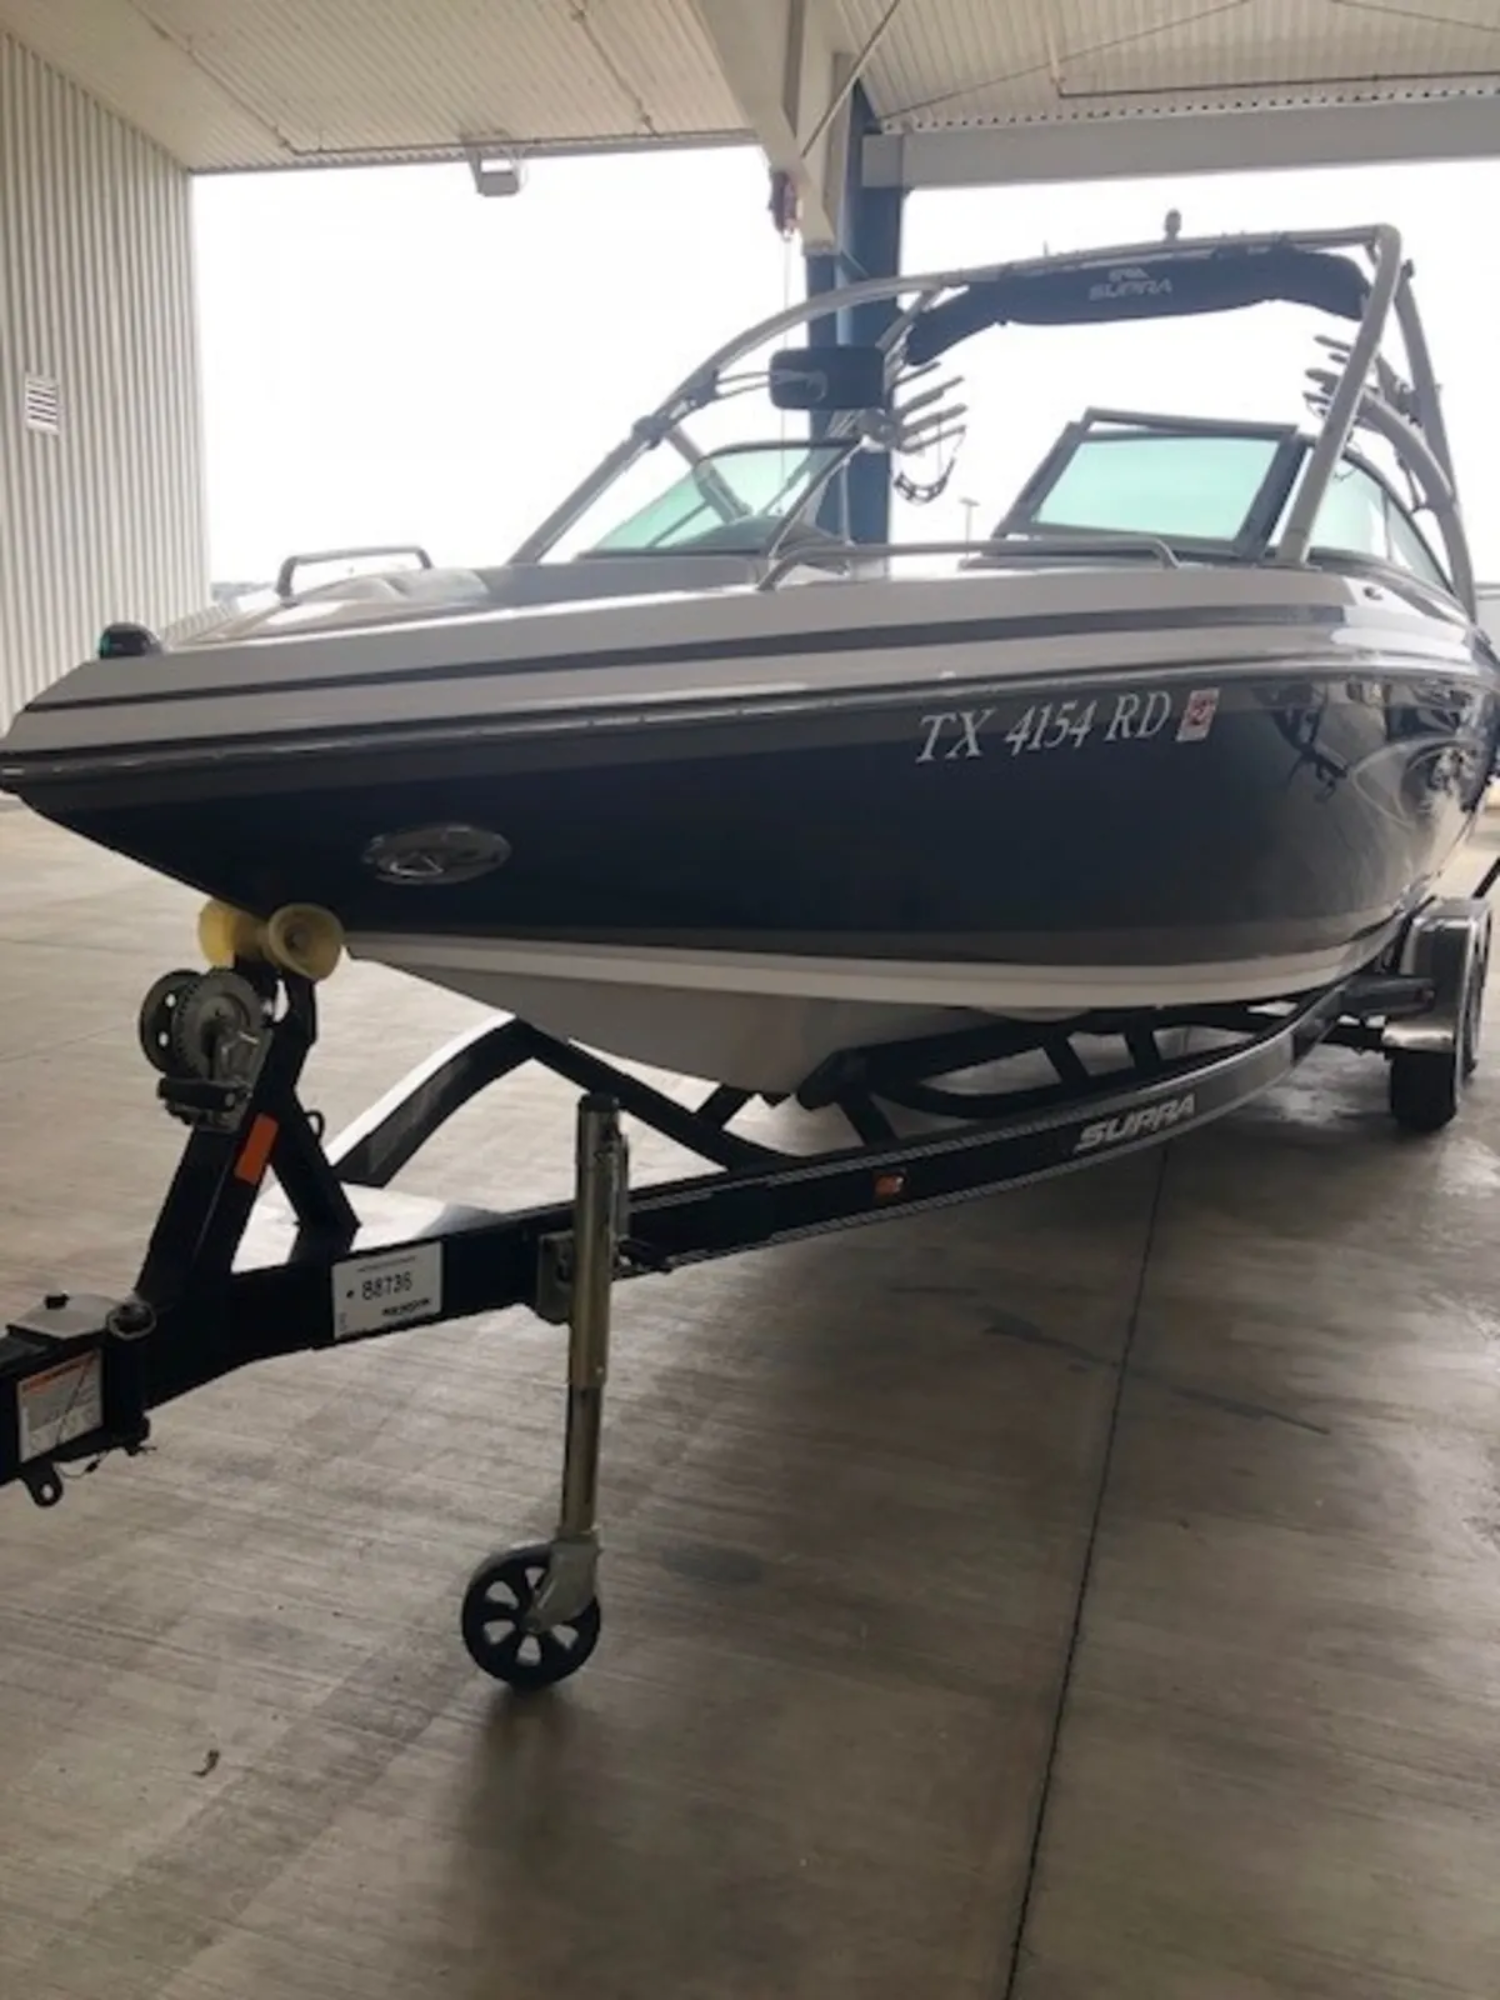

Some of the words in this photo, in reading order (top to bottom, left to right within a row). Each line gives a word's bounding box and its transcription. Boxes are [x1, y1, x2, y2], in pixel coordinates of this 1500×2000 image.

[1089, 278, 1173, 301] SUPRA
[915, 708, 998, 763] TX
[1003, 699, 1098, 756] 4154
[1103, 691, 1172, 741] RD
[1073, 1092, 1196, 1154] SUPRA
